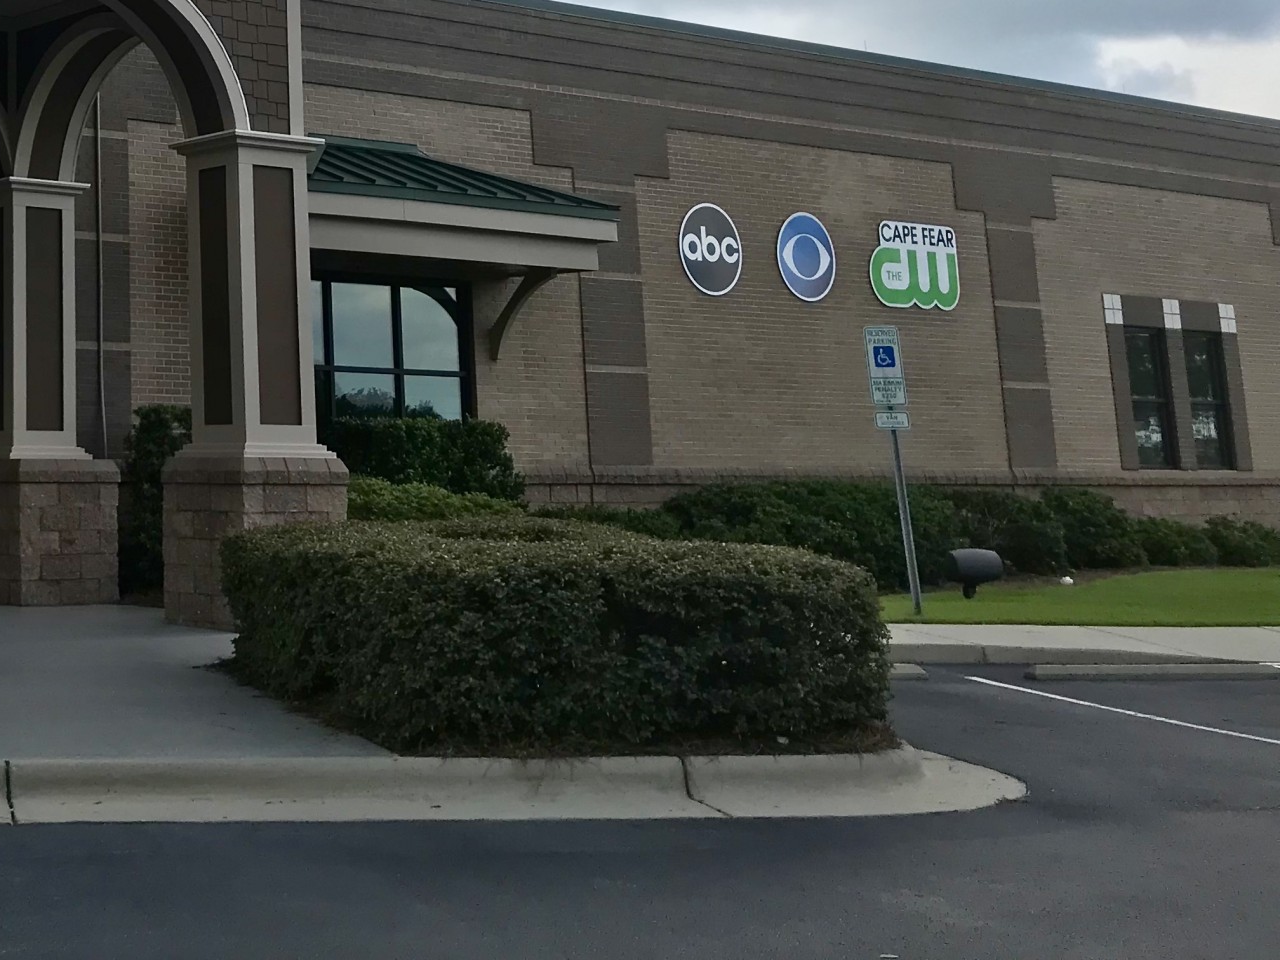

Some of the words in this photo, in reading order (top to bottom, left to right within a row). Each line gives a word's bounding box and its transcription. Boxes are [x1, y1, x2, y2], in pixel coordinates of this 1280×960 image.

[880, 223, 918, 245] CAPE
[921, 227, 954, 248] FEAR
[682, 225, 739, 264] abc
[886, 270, 903, 281] THE
[867, 329, 896, 337] RESERVED
[868, 337, 897, 345] PARKING
